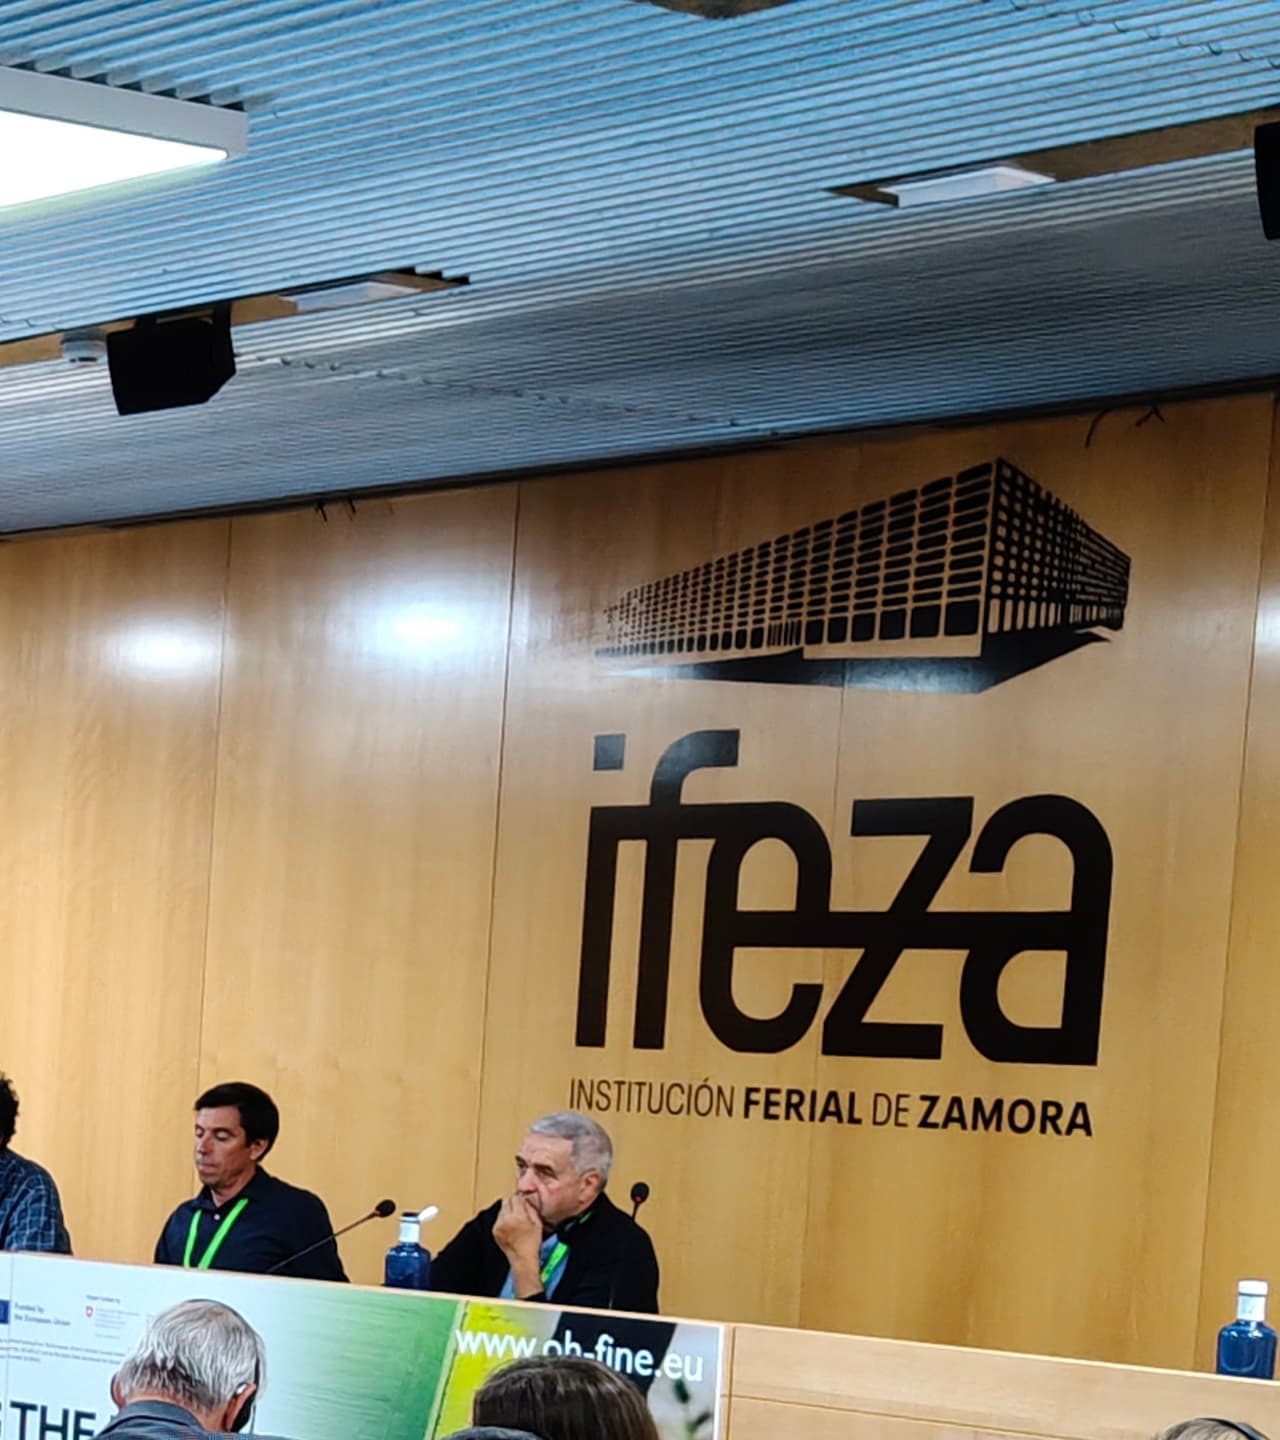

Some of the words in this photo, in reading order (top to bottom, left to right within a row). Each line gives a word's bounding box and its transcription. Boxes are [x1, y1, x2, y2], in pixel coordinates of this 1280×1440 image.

[575, 728, 1114, 1067] ifeza
[568, 1077, 736, 1119] INSTITUCIÓN
[742, 1086, 863, 1127] FERIAL
[871, 1092, 912, 1129] DE
[916, 1094, 1094, 1138] ZAMORA
[455, 1329, 704, 1382] wwwoh-fine.eu
